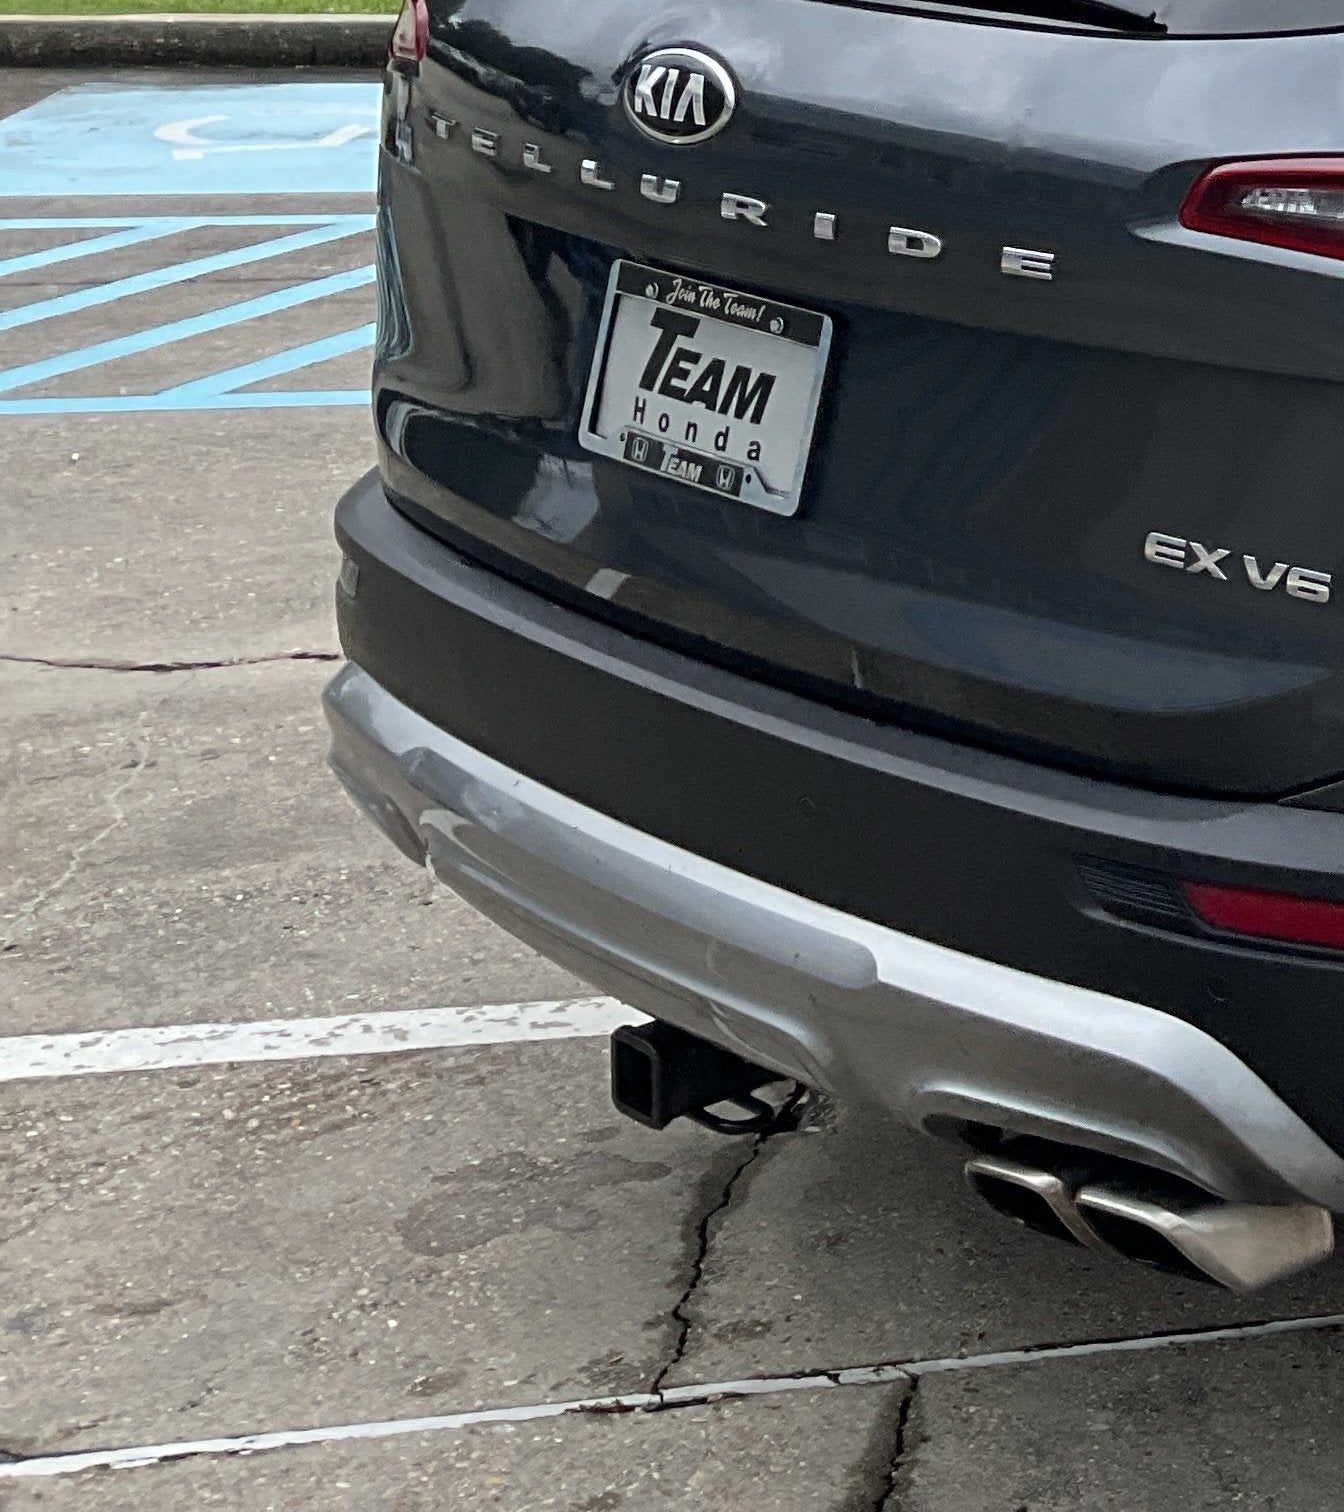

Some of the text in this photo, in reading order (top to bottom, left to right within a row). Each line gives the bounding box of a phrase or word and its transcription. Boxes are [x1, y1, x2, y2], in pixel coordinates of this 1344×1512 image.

[634, 63, 707, 127] KIA
[431, 110, 1055, 281] TELLURIDE
[665, 277, 767, 323] Join The Team!
[638, 307, 777, 426] TEAM
[632, 395, 762, 462] Honda
[1144, 531, 1333, 604] EX V6
